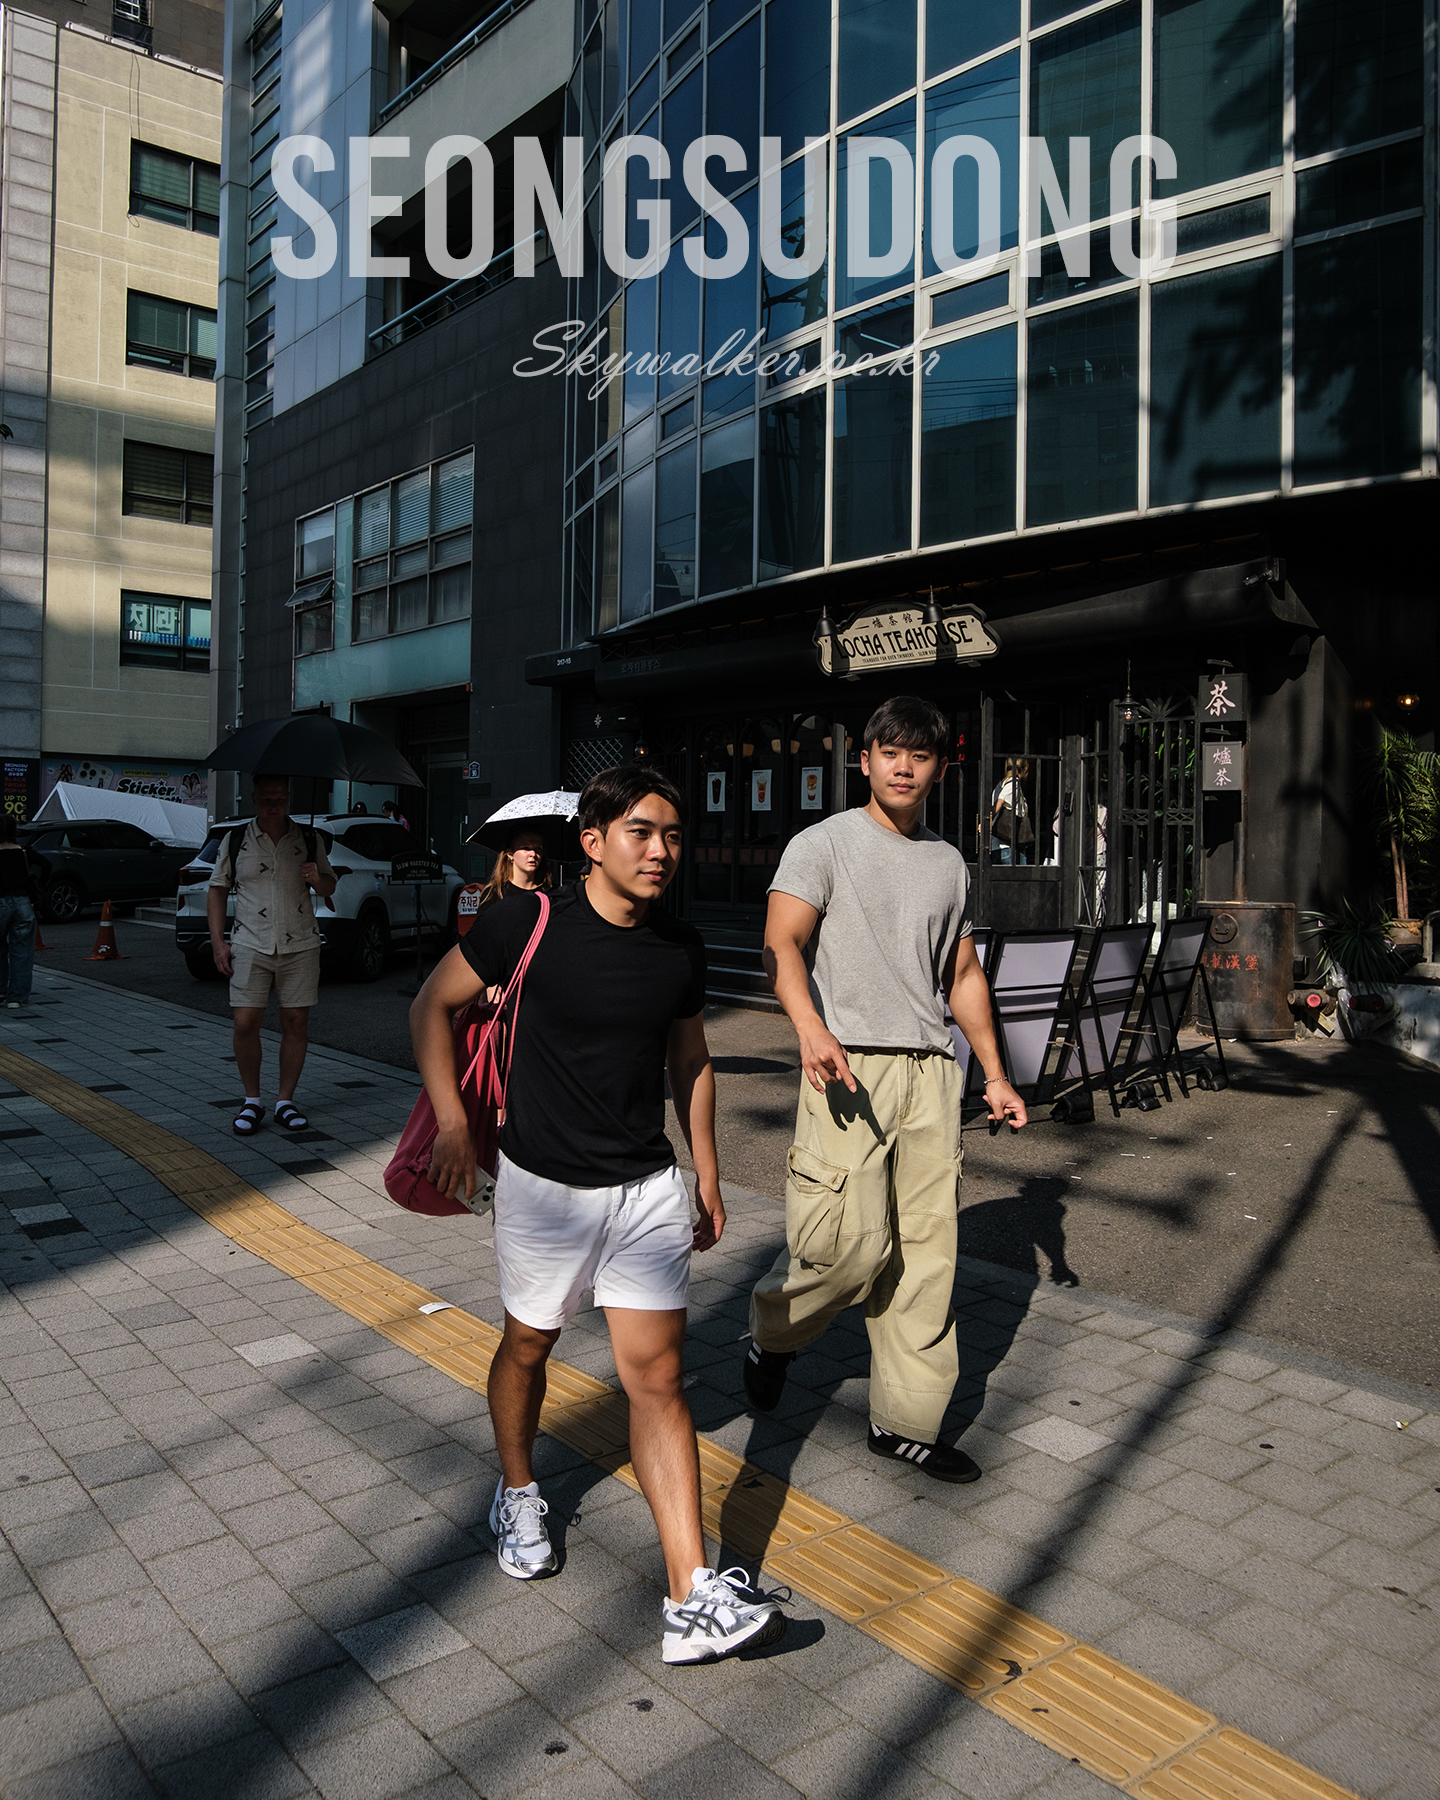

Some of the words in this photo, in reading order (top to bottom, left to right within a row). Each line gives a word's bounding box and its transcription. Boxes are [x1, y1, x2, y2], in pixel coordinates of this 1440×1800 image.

[833, 633, 886, 660] LOCHA
[883, 620, 973, 654] TEAHOUSE
[1204, 680, 1236, 717] 茶
[116, 779, 175, 796] Sticker
[396, 861, 409, 871] SLOW
[409, 860, 430, 868] ROASTED
[430, 861, 439, 870] TEA
[460, 896, 481, 908] 주차금
